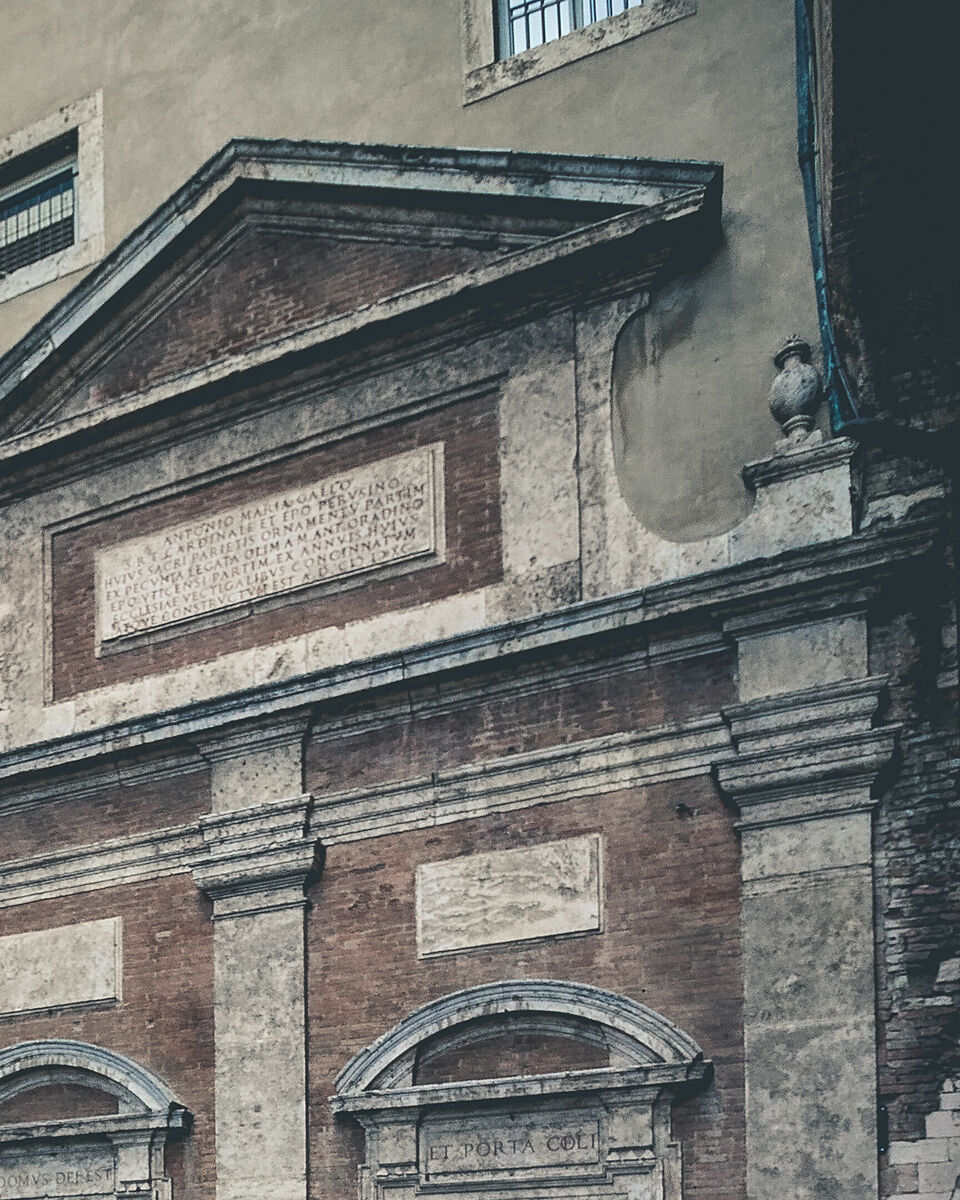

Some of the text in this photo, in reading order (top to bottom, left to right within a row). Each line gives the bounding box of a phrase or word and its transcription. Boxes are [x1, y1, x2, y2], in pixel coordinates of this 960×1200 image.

[104, 568, 143, 589] HVIVS
[147, 555, 186, 577] SACRI
[191, 534, 254, 563] PARIETIS
[365, 481, 425, 511] PARTIM
[164, 478, 351, 546] ANTONIO MARIA GALLO
[188, 553, 239, 577] LEGATA
[347, 496, 424, 530] ORADINO
[212, 557, 268, 582] PARTIM
[302, 529, 361, 556] ANNVIS
[368, 512, 419, 537] HVIVS
[113, 526, 416, 624] ECCLESIAE VECTIGALIBVS CONCINNATVM
[429, 1144, 453, 1161] ET
[464, 1139, 535, 1158] PORTA
